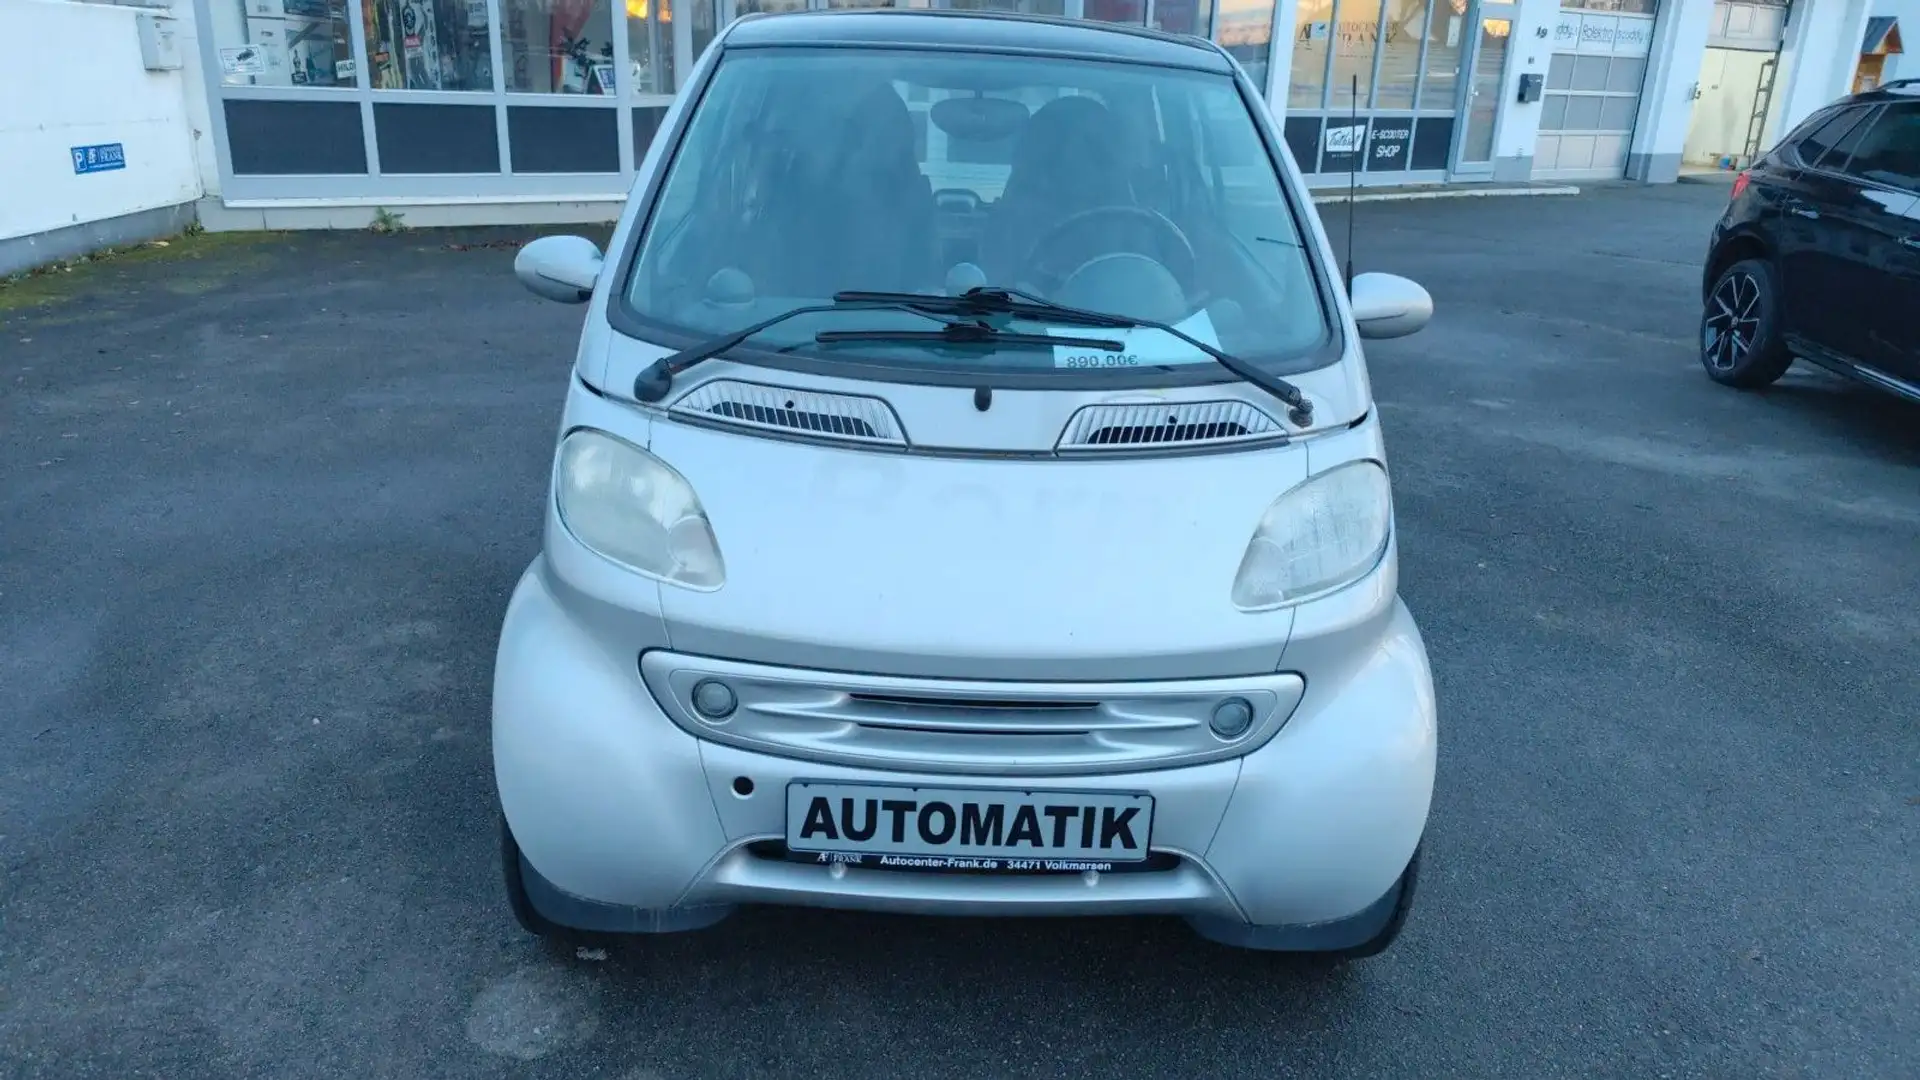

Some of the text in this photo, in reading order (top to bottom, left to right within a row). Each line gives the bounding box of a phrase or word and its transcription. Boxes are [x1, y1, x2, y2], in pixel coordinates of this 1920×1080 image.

[1376, 145, 1400, 158] SHOP
[799, 796, 1142, 849] AUTOMATIK
[880, 854, 1112, 871] Autocenter-Frank.de 34471 Volkmarsen
